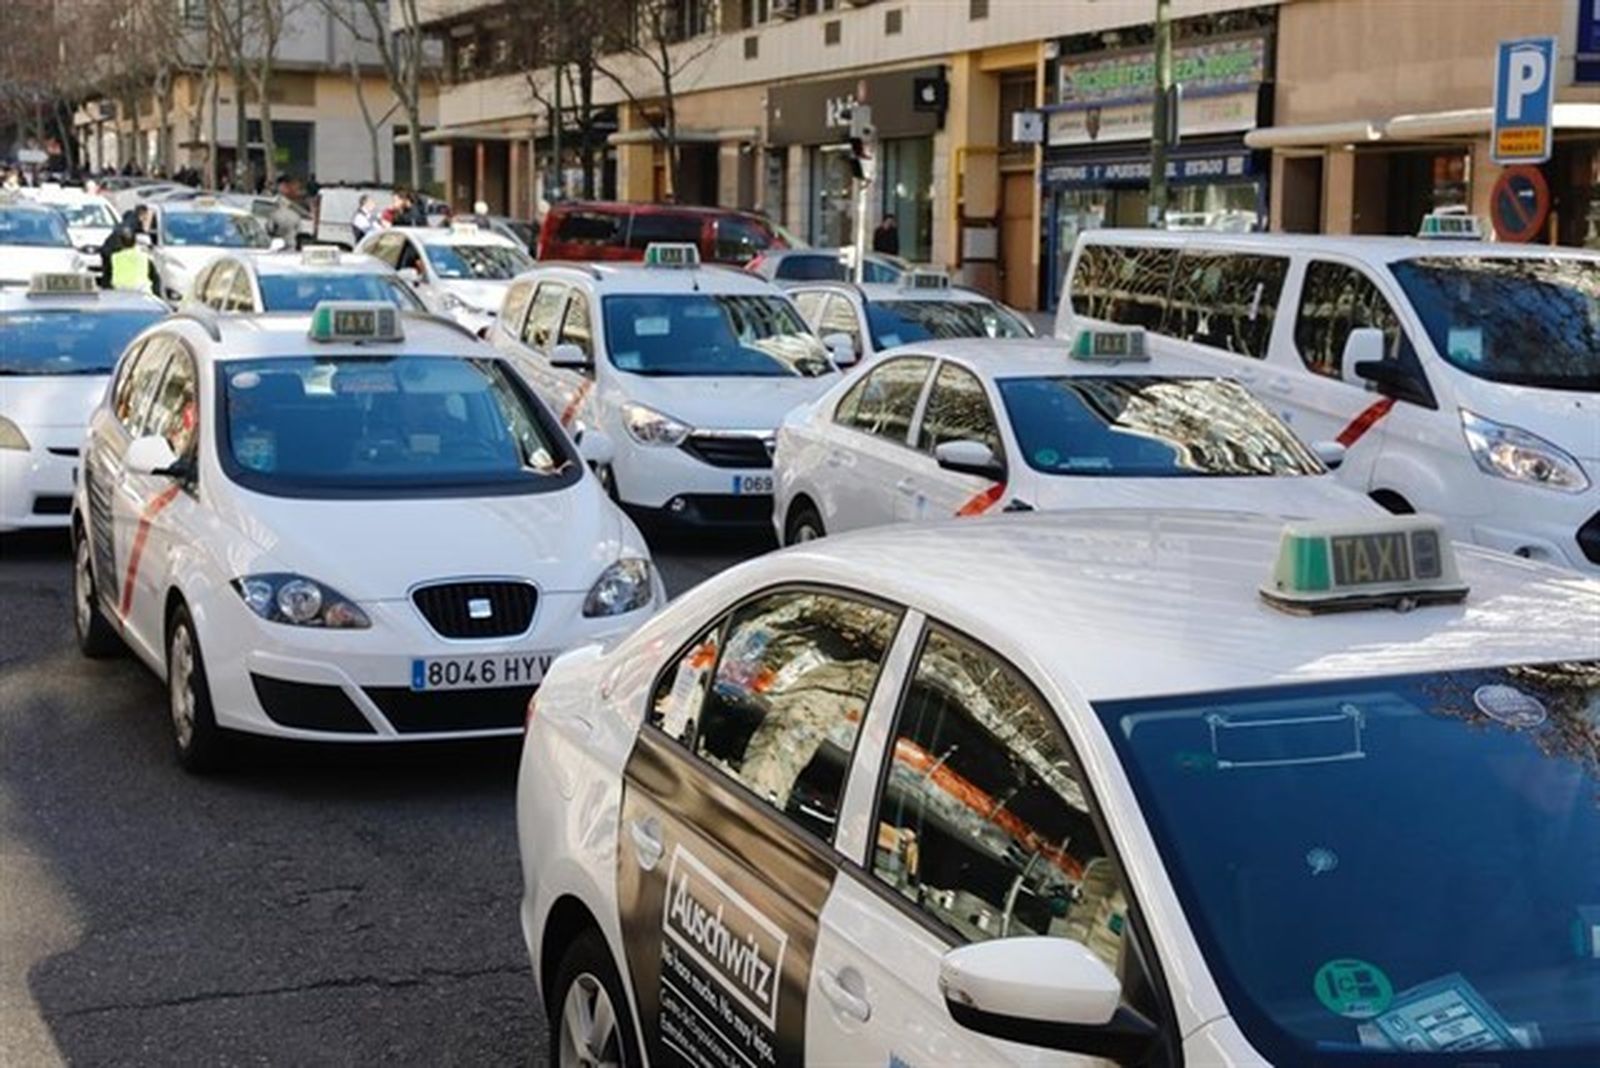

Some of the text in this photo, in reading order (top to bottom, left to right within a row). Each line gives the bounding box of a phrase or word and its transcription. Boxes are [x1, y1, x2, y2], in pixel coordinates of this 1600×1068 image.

[1506, 51, 1546, 120] P
[337, 312, 374, 333] TAXI
[1334, 535, 1407, 582] TAXI
[428, 655, 552, 686] 8046 HYV
[671, 873, 772, 1004] Auschwitz
